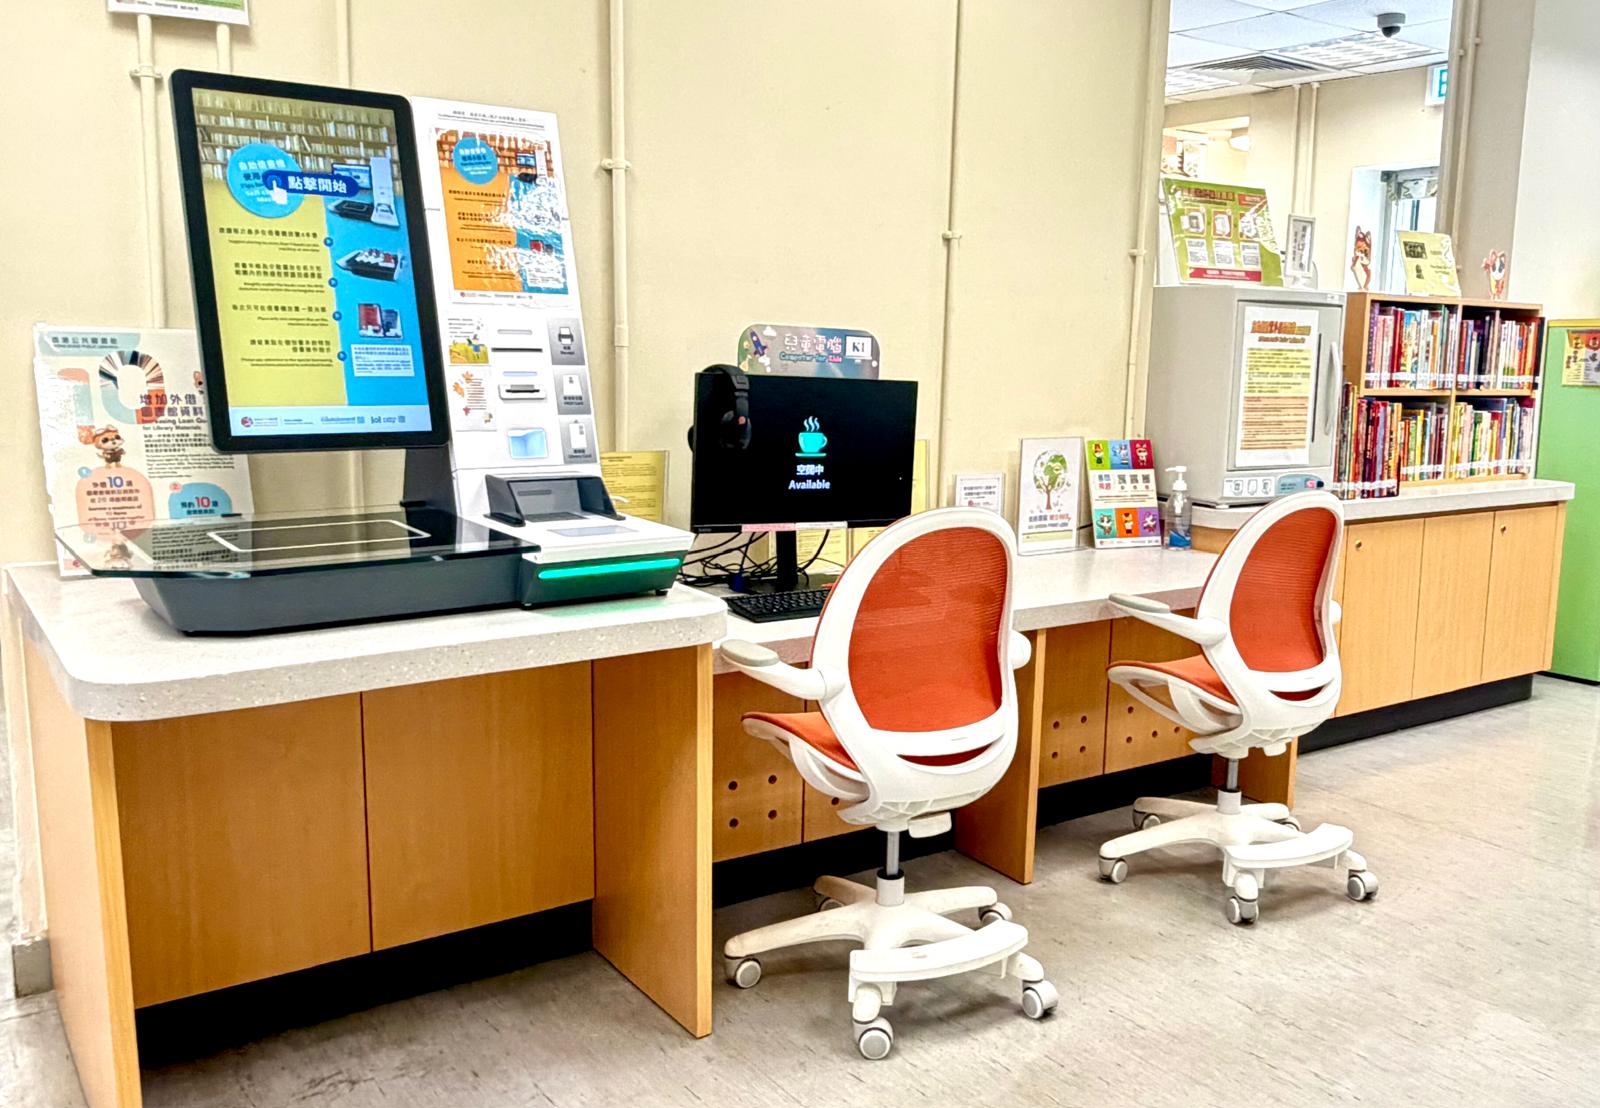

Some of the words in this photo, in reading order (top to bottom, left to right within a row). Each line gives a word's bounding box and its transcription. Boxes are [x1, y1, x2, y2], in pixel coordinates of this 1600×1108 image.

[288, 176, 348, 194] 點擊開始
[51, 336, 118, 344] 香港公共圖書館
[784, 334, 842, 354] 兒童電腦
[779, 351, 814, 362] Computer
[828, 354, 842, 363] Kids
[140, 394, 196, 406] 增加外借
[141, 406, 203, 417] 圖書館資料
[108, 476, 124, 488] 10
[788, 479, 831, 490] Available
[195, 496, 211, 507] 10
